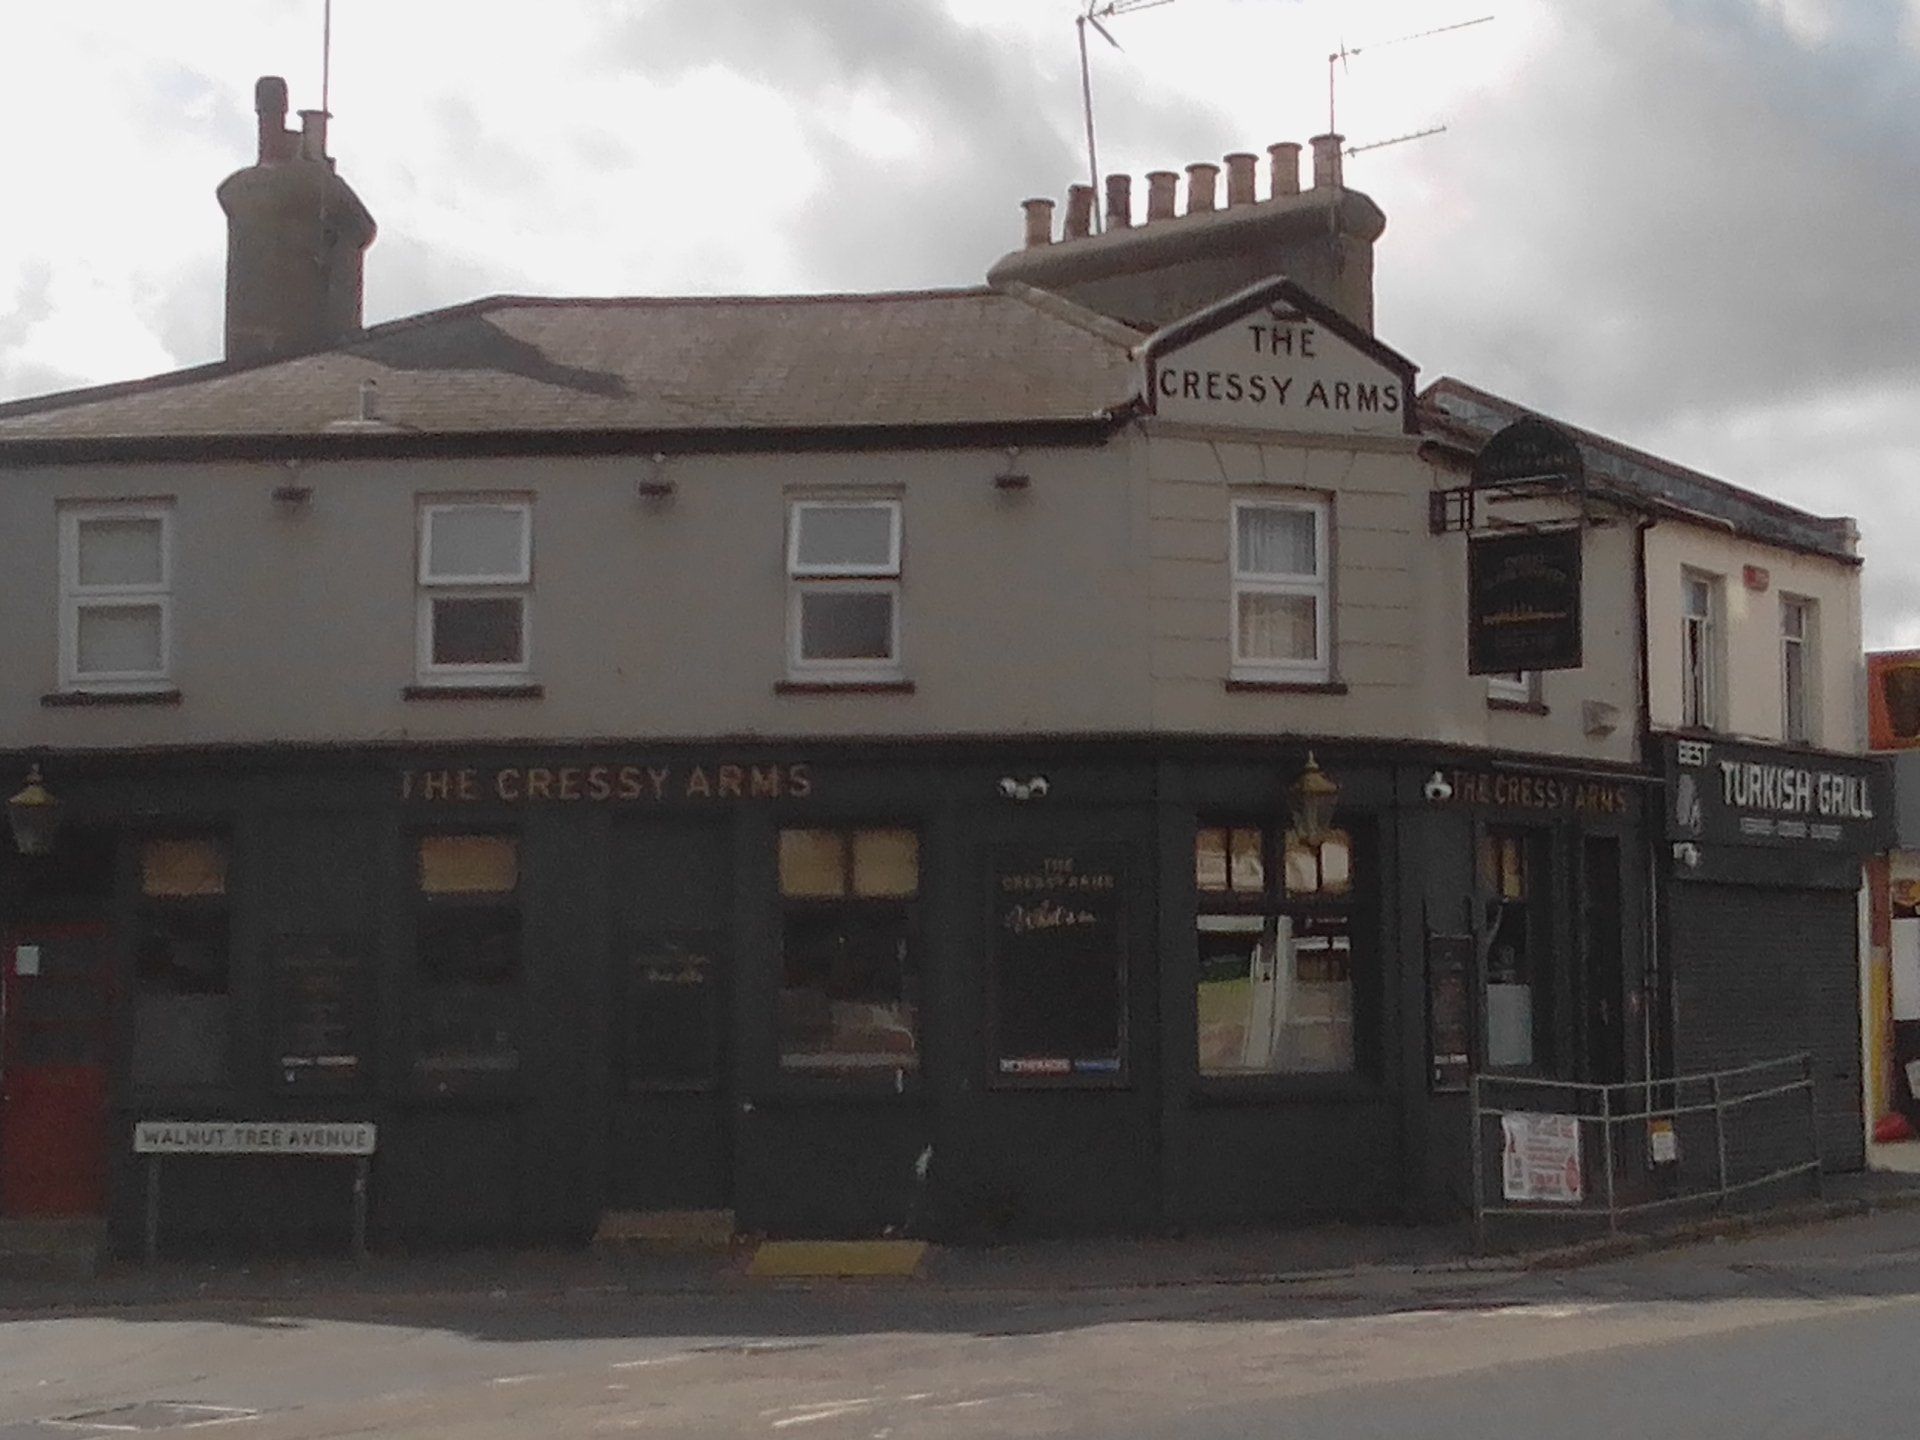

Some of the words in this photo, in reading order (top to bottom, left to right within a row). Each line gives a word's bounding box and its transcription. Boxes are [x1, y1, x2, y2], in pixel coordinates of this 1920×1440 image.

[1248, 325, 1315, 358] THE
[1159, 369, 1293, 406] CRESSY
[1305, 379, 1399, 414] ARMS
[401, 768, 478, 801] THE
[498, 766, 670, 801] CRESSY
[686, 764, 812, 799] ARMS
[1453, 770, 1490, 804] THE
[1495, 774, 1571, 808] CRESSY
[1720, 760, 1811, 813] TURKISH
[1819, 773, 1874, 819] GRILL
[143, 1129, 224, 1146] WALNUT
[235, 1129, 282, 1147] TREE
[289, 1129, 366, 1148] AVENUE
